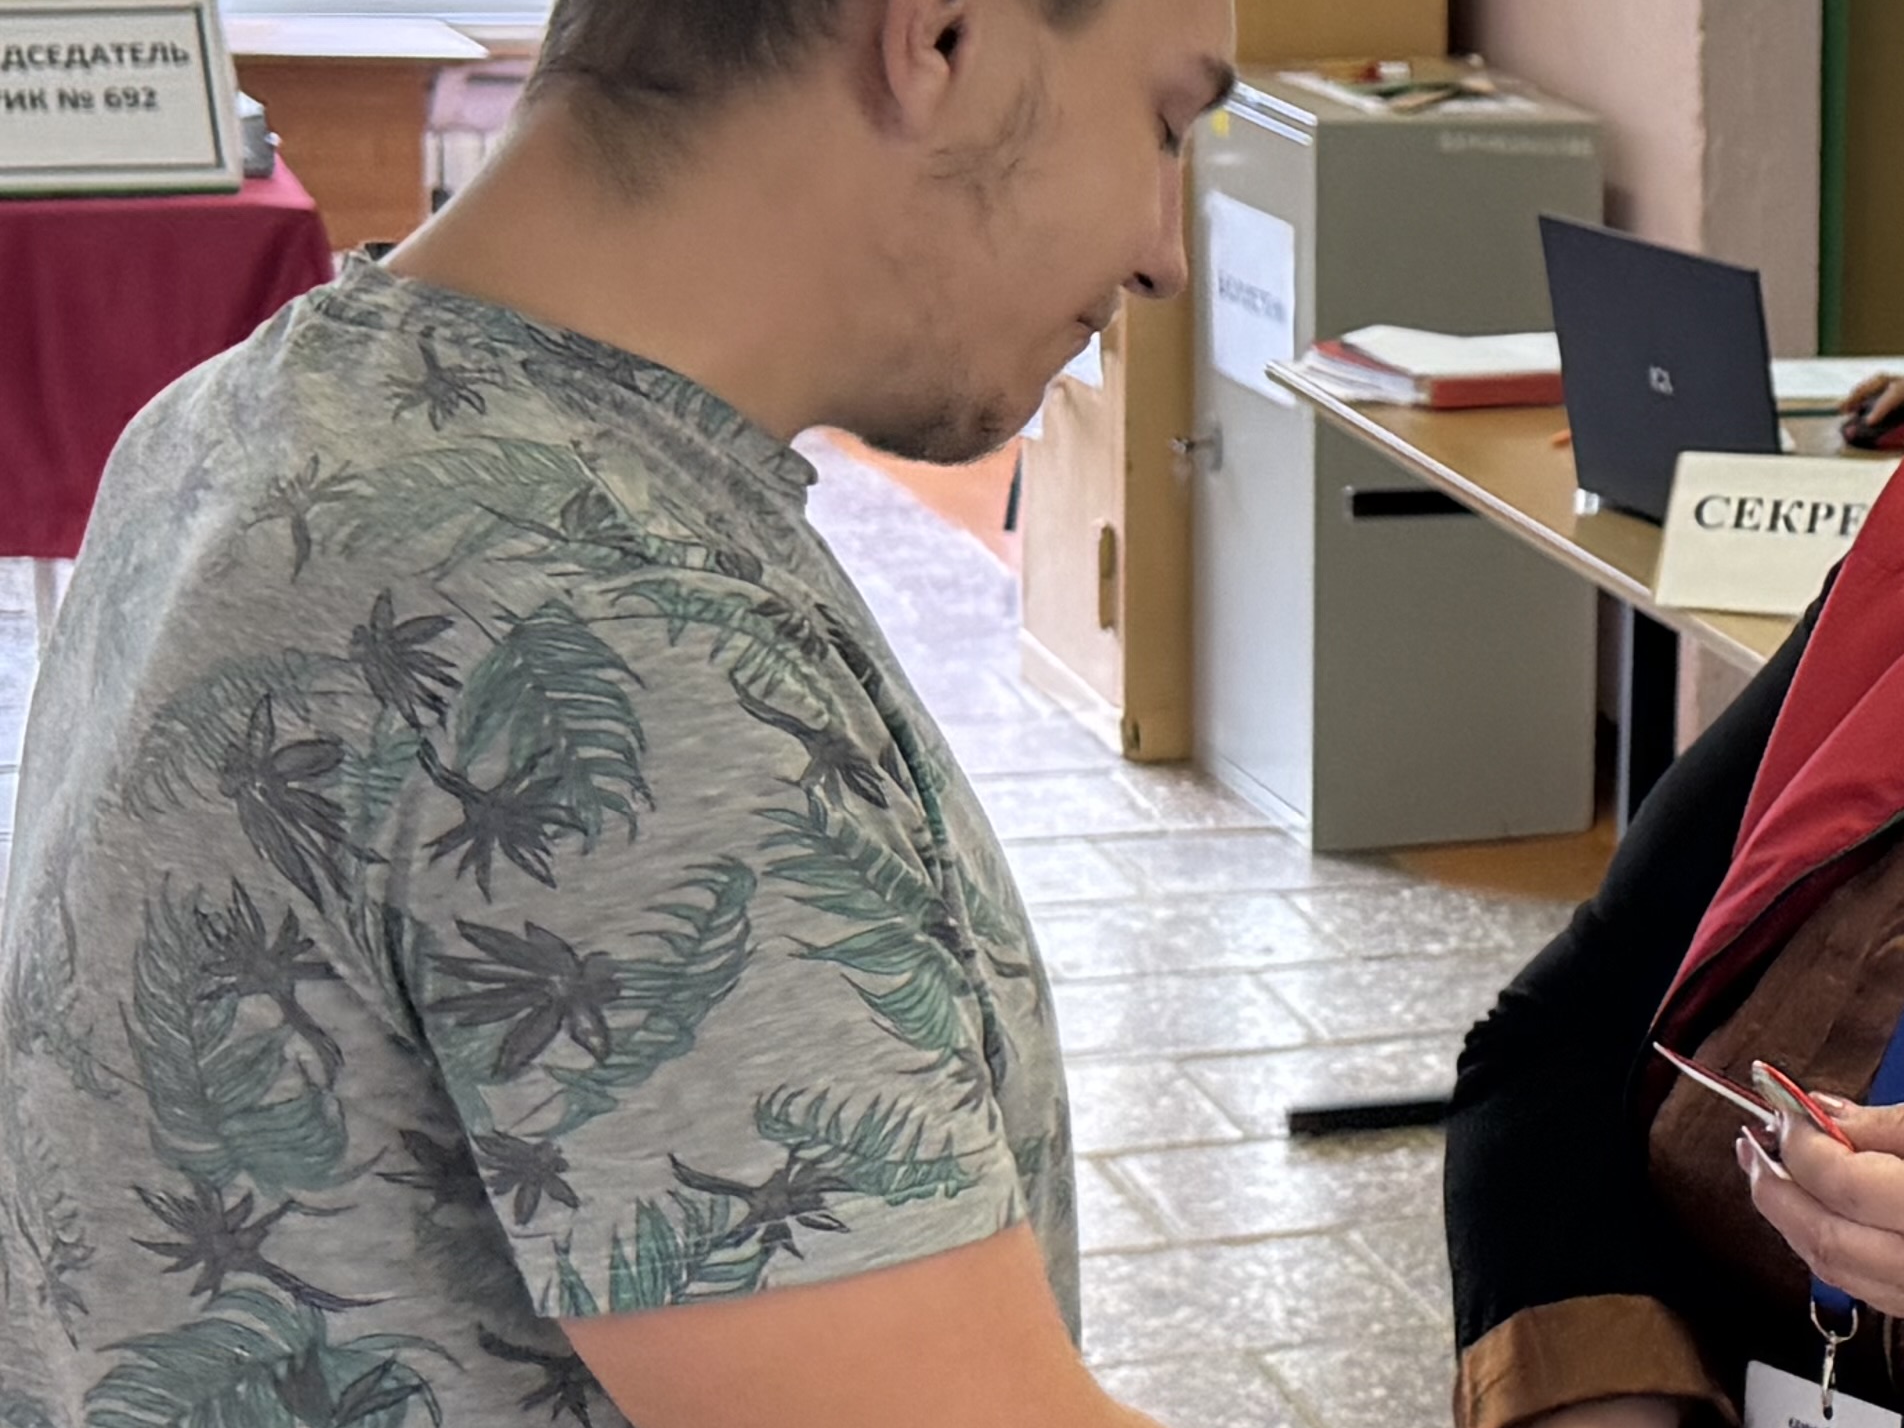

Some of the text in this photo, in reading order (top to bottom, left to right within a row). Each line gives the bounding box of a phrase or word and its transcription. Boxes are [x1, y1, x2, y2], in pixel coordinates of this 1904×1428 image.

[0, 86, 159, 111] ИК № 692
